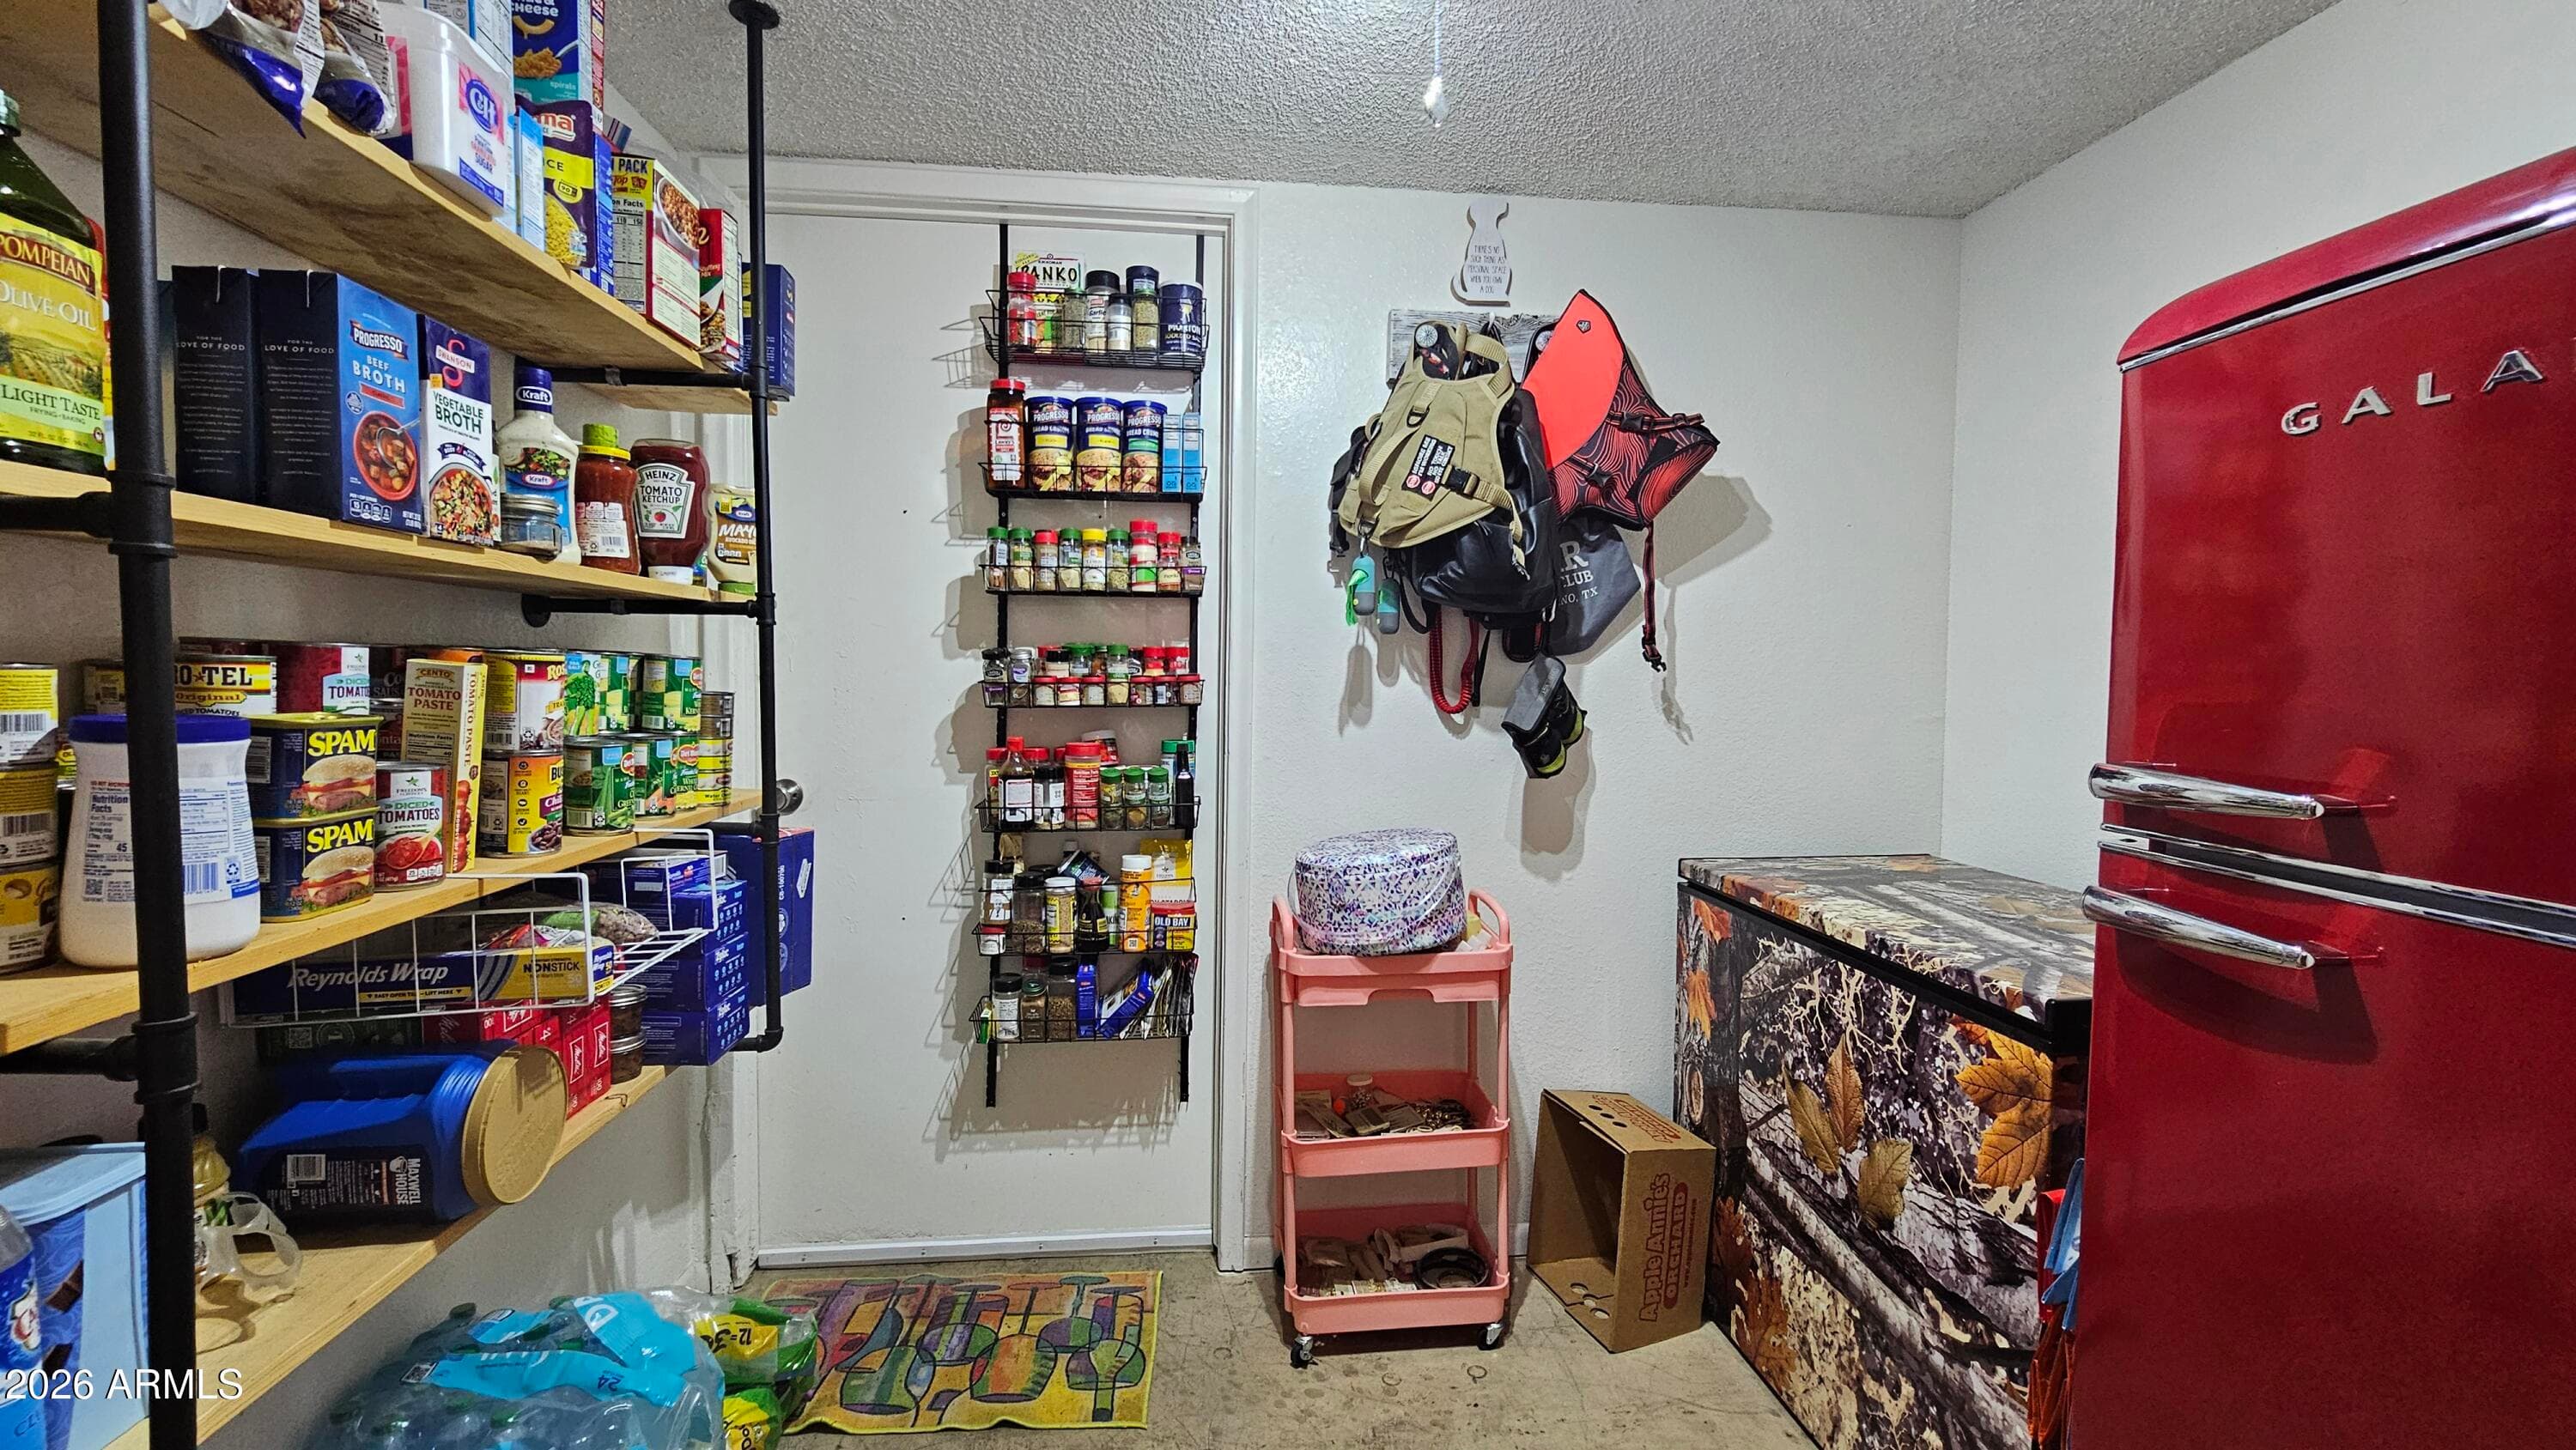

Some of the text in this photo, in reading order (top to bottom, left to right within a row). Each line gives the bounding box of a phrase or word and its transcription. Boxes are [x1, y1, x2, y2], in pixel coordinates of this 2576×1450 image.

[550, 81, 576, 90] spirals
[470, 87, 495, 125] C&H
[619, 158, 647, 173] PACK
[623, 198, 643, 208] Facts
[0, 280, 95, 331] OLIVE OIL
[353, 328, 404, 354] PROGRESSO
[366, 355, 390, 370] BEEF
[437, 347, 473, 370] SWANSON
[352, 360, 407, 394] BROTH
[521, 390, 549, 403] Kraft
[2280, 348, 2543, 436] GALA
[3, 385, 100, 421] LIGHT TASTE
[433, 391, 484, 420] VEGETABLE
[434, 404, 483, 434] BROTH
[529, 474, 550, 484] Kraft
[645, 470, 677, 482] HEINZ
[640, 485, 683, 497] TOMATO
[642, 495, 681, 504] KETCHUP
[1561, 570, 1594, 587] LUB
[1582, 586, 1598, 599] TX
[345, 676, 370, 685] DICE
[420, 668, 450, 678] CENTO
[176, 692, 240, 704] Original
[407, 687, 461, 701] TOMATO
[196, 707, 240, 716] TOMATOES
[414, 699, 454, 711] PASTE
[464, 672, 477, 766] TOMATO PASTE
[307, 729, 375, 757] SPAM
[92, 794, 129, 804] Nutrition
[91, 803, 112, 813] Facts
[378, 808, 440, 824] TOMATOES
[306, 819, 374, 853] SPAM
[116, 842, 128, 852] 45
[1155, 917, 1189, 926] OLD BAY
[523, 961, 580, 973] NONSTICK
[287, 962, 448, 992] Reynolds Wrap
[408, 1158, 422, 1204] MAXWELL
[395, 1173, 410, 1205] HOUSE
[1639, 1173, 1670, 1322] Apple Annie's
[1665, 1189, 1687, 1300] ORCHARD
